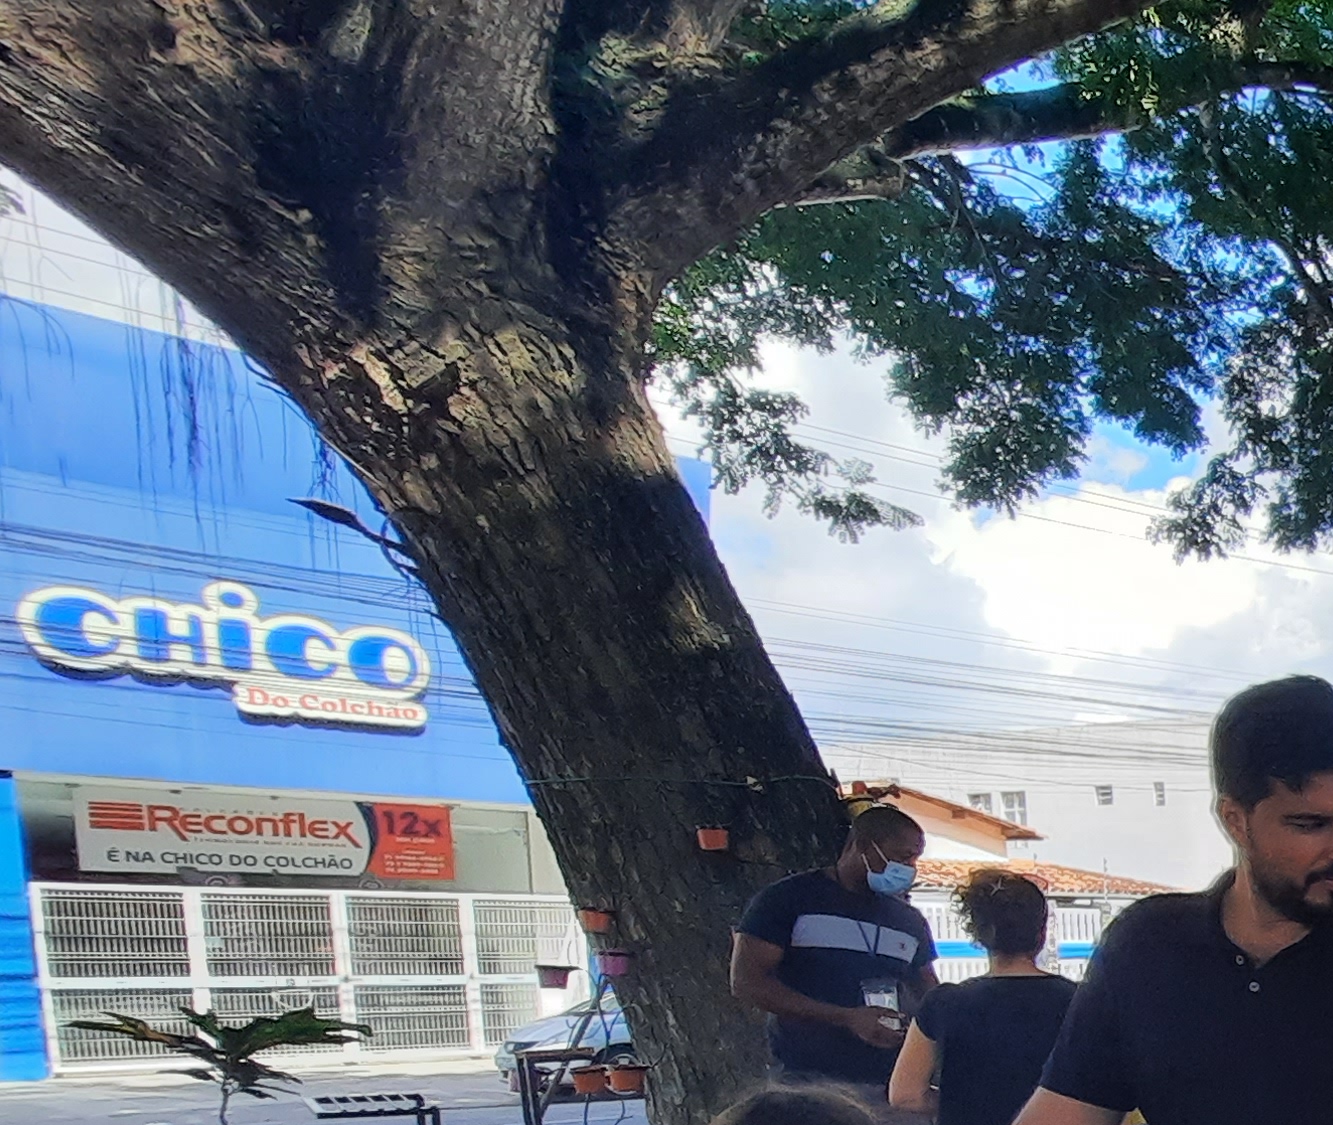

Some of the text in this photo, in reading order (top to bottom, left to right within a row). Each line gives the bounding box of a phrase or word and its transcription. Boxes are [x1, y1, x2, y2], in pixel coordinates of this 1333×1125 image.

[247, 686, 420, 721] Do Colchão
[125, 850, 156, 864] NA
[160, 851, 223, 867] CHICO
[229, 854, 258, 868] DO
[262, 854, 354, 871] COLCHÃO
